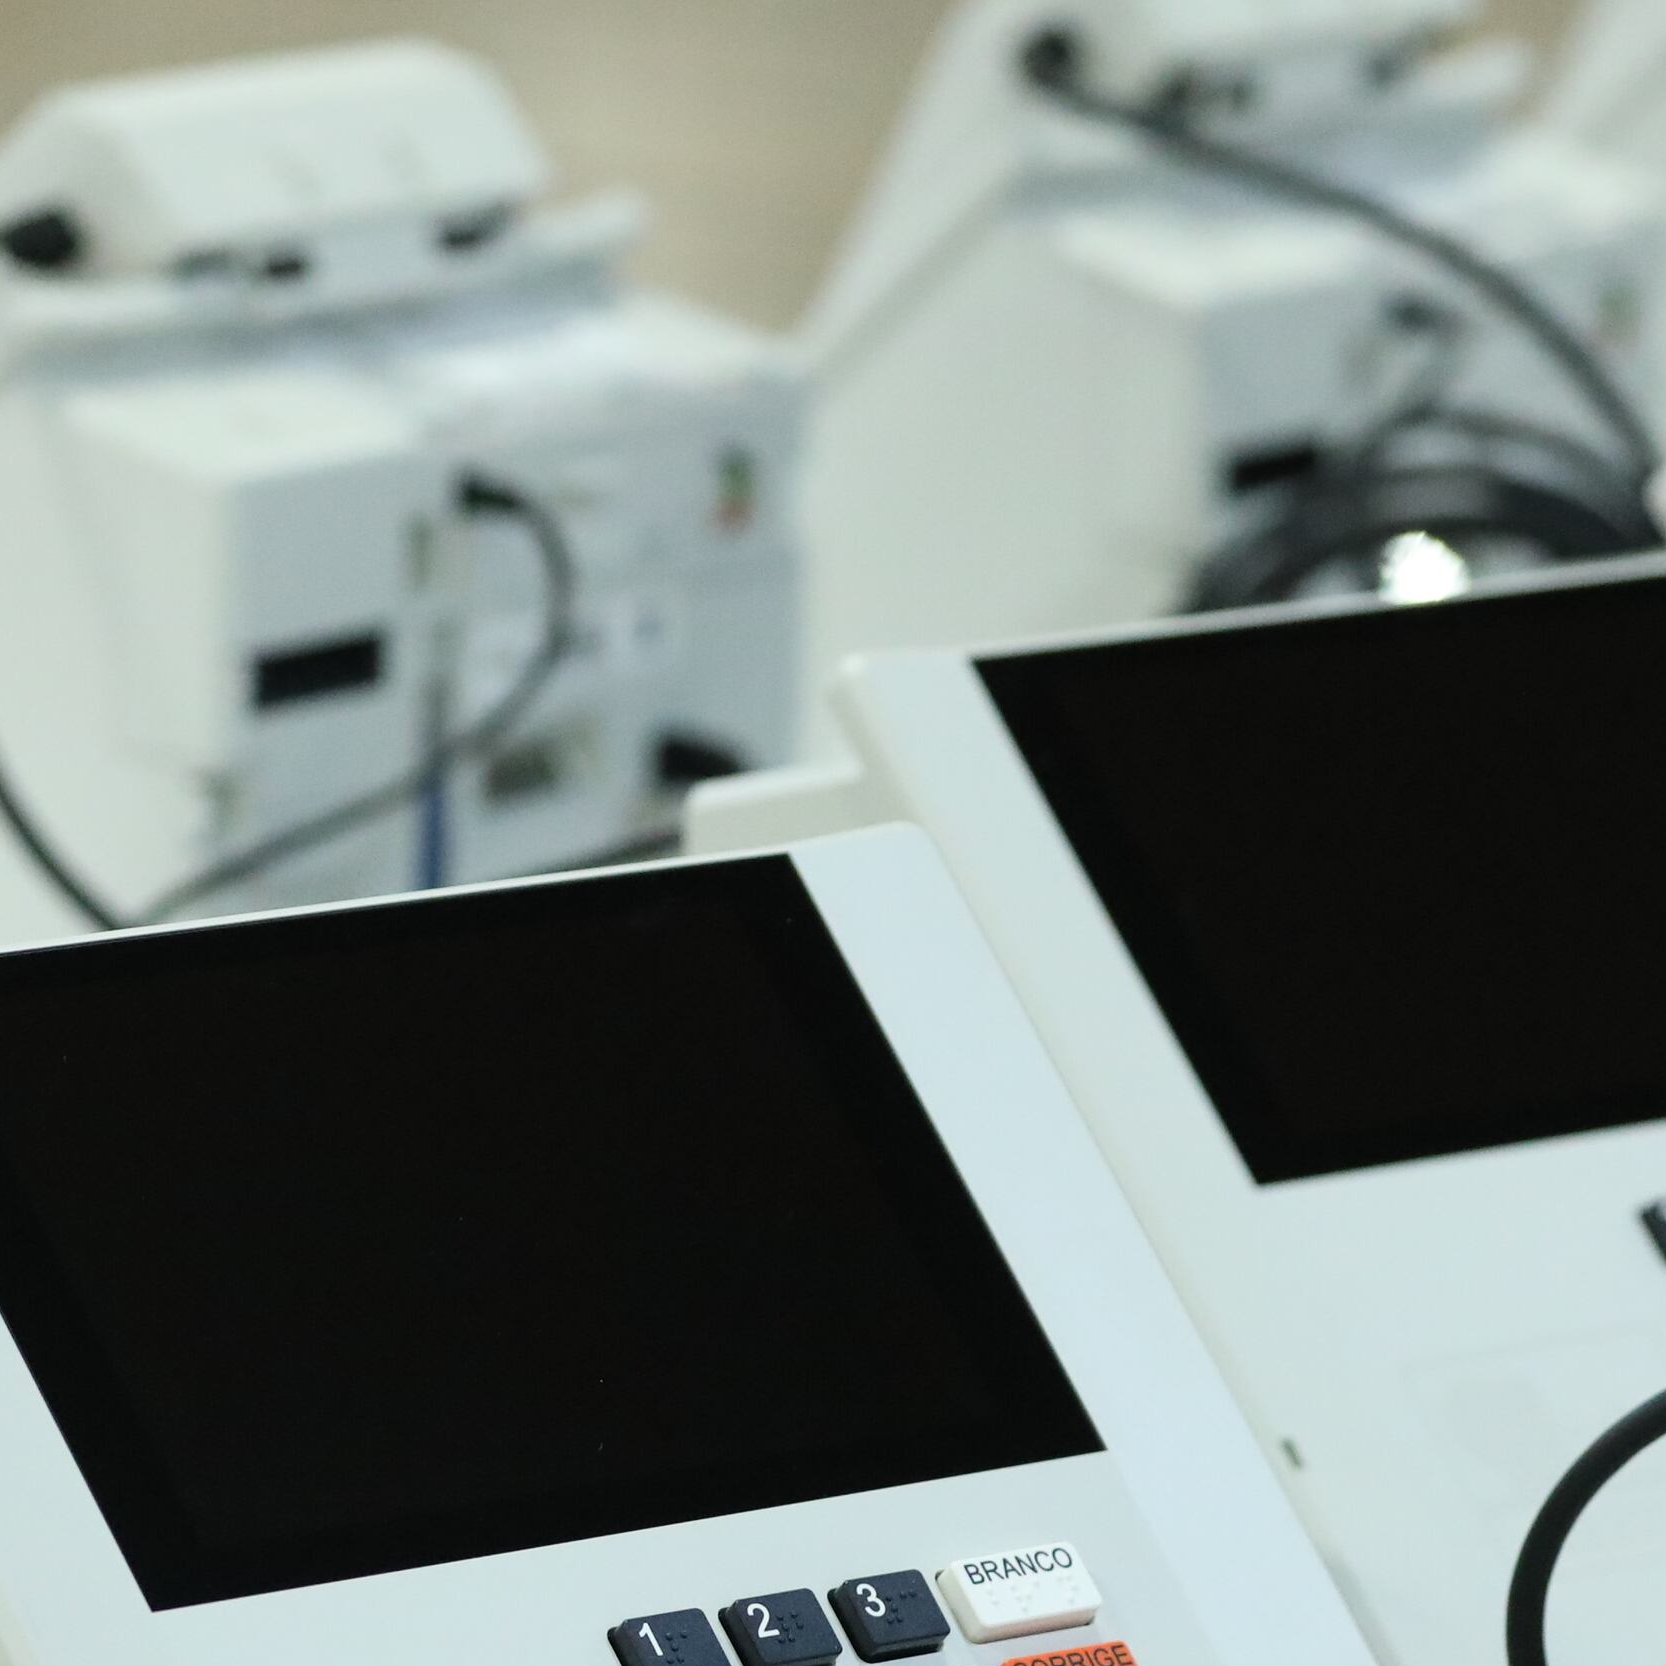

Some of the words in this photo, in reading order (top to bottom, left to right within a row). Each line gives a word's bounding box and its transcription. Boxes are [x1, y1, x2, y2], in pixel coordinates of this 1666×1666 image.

[963, 1547, 1073, 1585] BRANCO
[856, 1583, 887, 1617] 3
[747, 1603, 780, 1638] 2
[638, 1622, 664, 1656] 1
